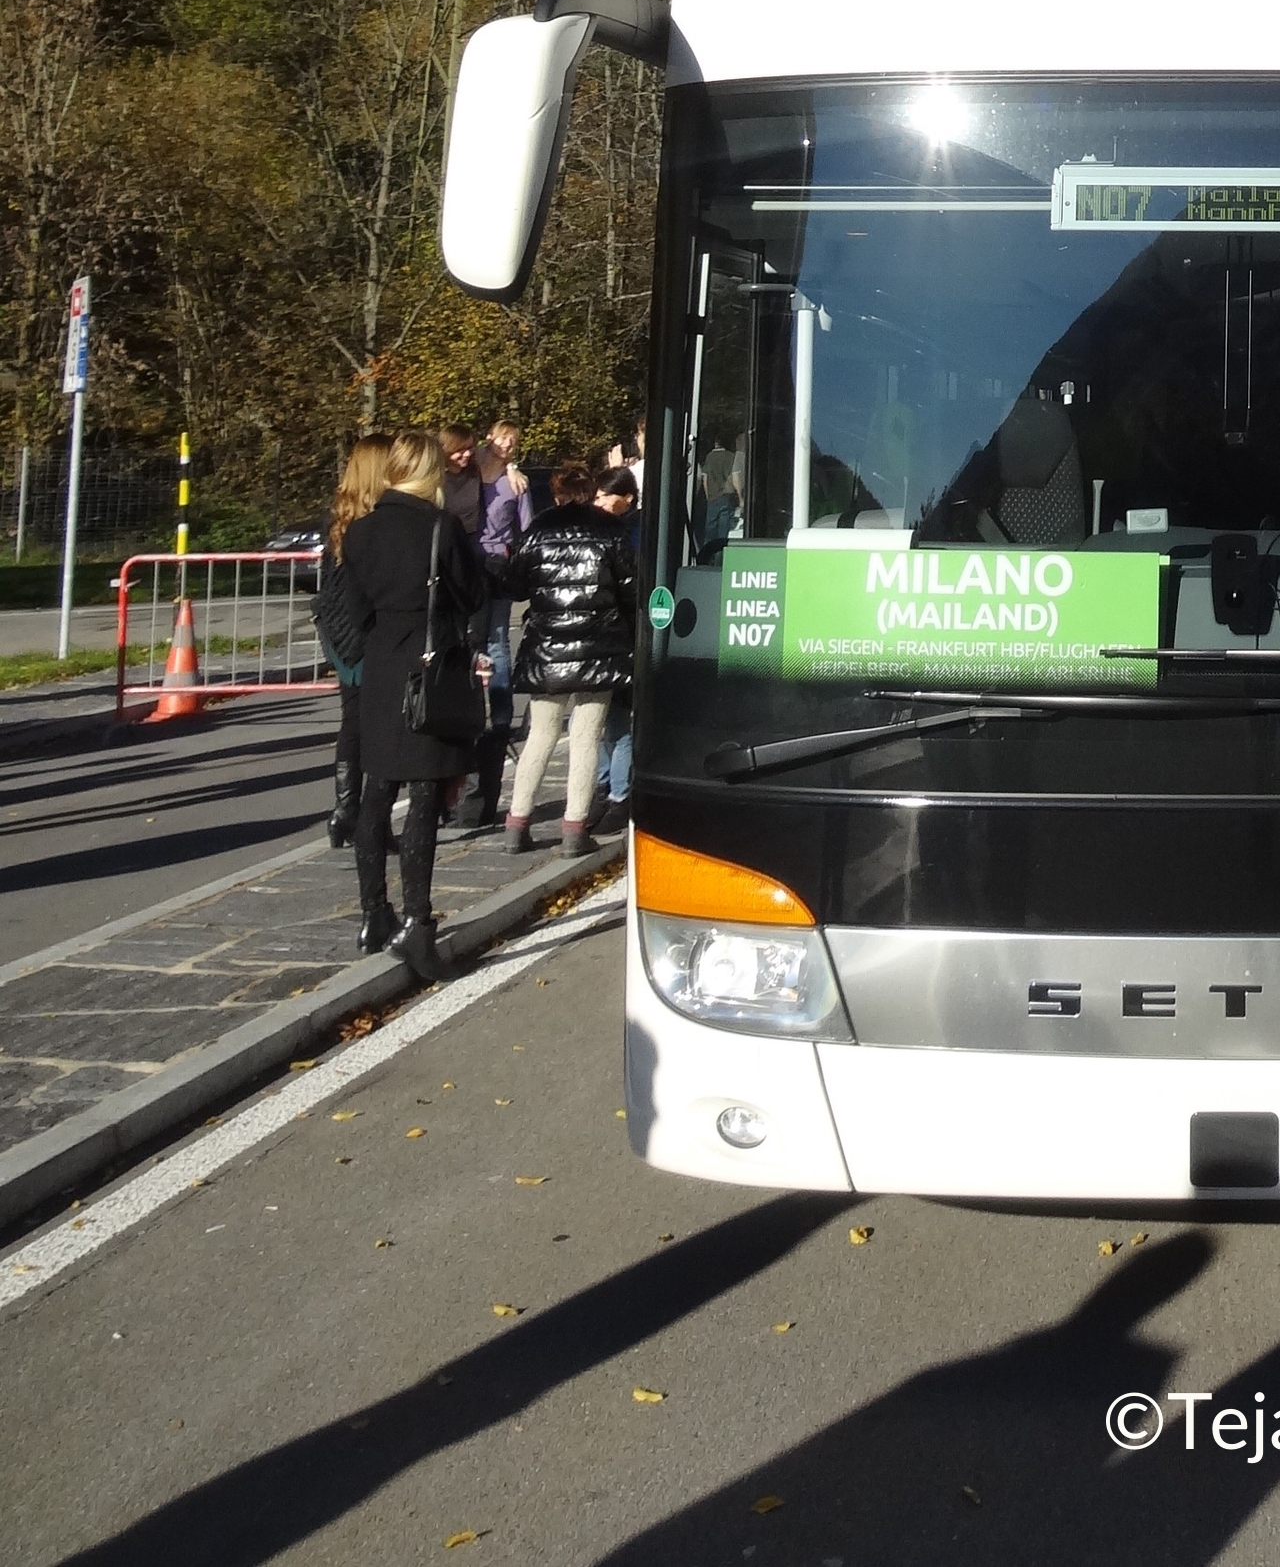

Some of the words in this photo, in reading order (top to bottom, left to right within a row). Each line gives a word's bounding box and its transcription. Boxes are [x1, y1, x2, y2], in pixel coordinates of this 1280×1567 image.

[1077, 185, 1151, 221] N07
[730, 571, 778, 589] LINIE
[865, 552, 1074, 597] MILANO
[656, 588, 665, 608] 4
[725, 599, 780, 618] LINEA
[876, 598, 1059, 638] (MAILAND)
[728, 623, 776, 646] N07
[799, 637, 825, 654] VIA
[827, 638, 884, 656] SIEGEN
[897, 640, 998, 658] FRANKFURT
